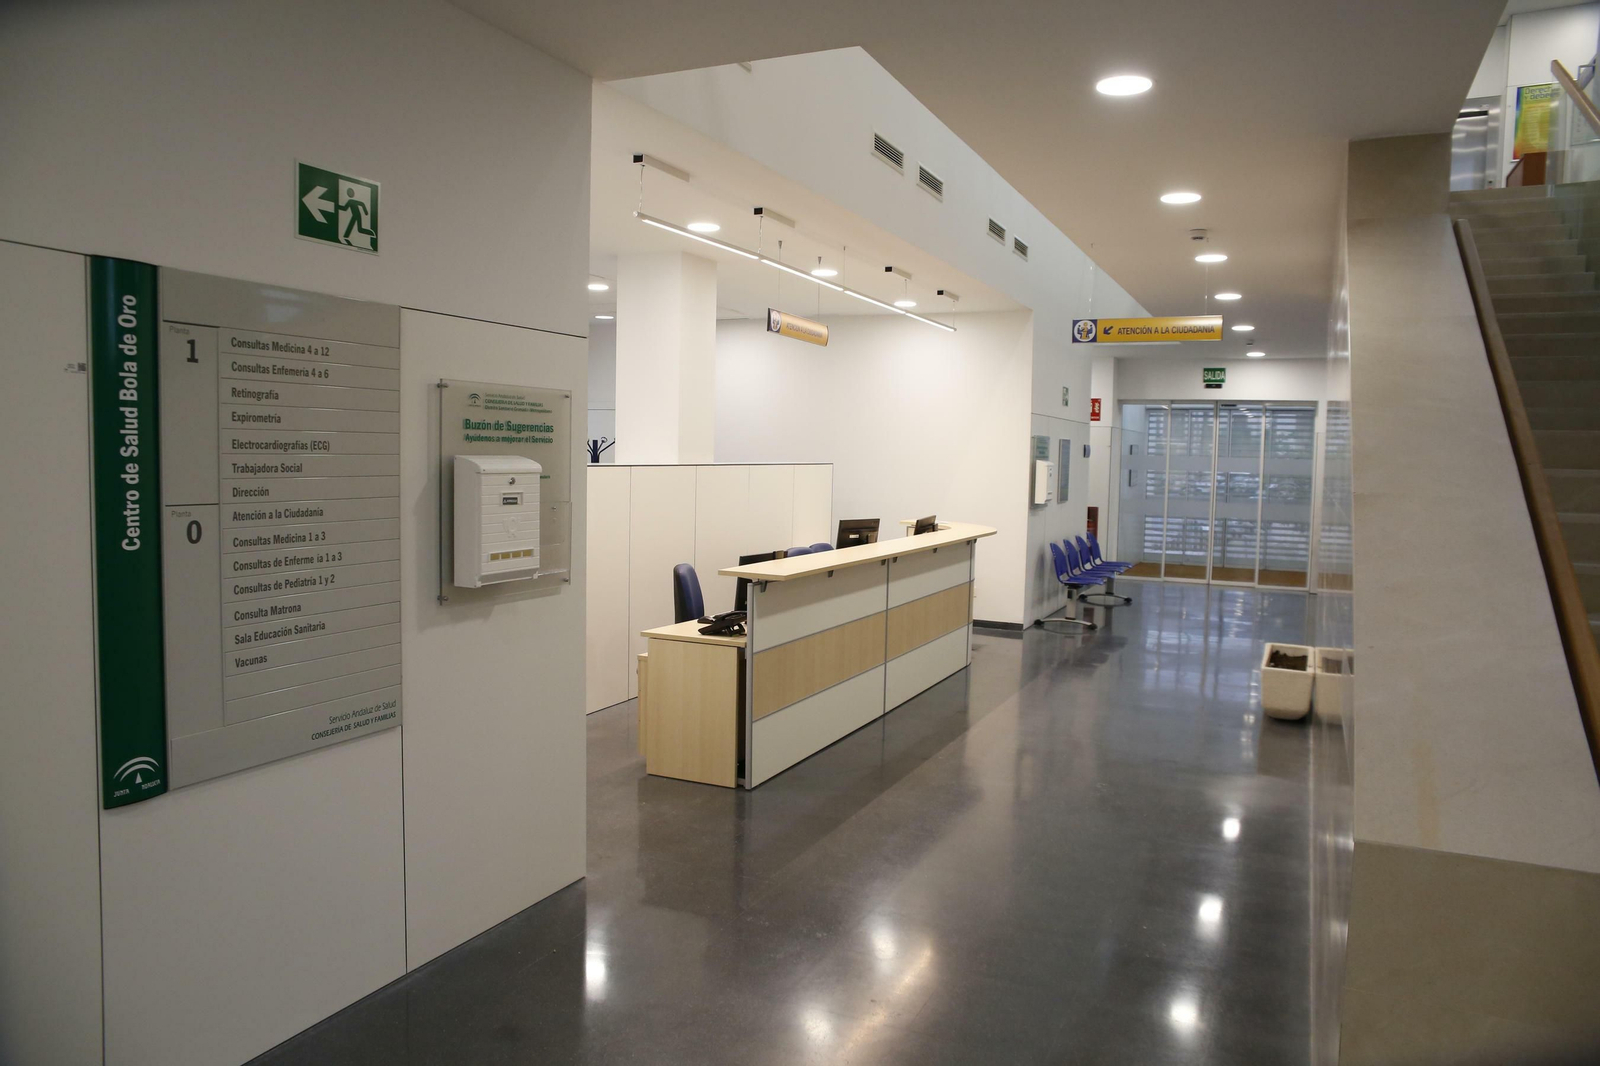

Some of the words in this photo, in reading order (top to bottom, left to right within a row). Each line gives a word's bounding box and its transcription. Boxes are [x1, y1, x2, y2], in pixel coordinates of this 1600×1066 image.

[117, 294, 137, 328] Oro
[169, 325, 190, 335] Planta
[1118, 325, 1152, 334] ATENCIÓN
[1154, 326, 1159, 334] A
[1161, 326, 1170, 334] LA
[1171, 324, 1215, 334] CIUDADANÍA
[118, 334, 137, 356] de
[186, 339, 198, 363] 1
[231, 337, 270, 350] Consultas
[272, 341, 305, 354] Medicina
[307, 345, 312, 354] 4
[321, 347, 330, 356] 12
[231, 361, 270, 374] Consultas
[311, 368, 316, 377] 4
[324, 369, 329, 379] 6
[1204, 370, 1225, 380] SALIDA
[118, 361, 138, 401] Bola
[119, 407, 139, 457] Salud
[464, 418, 492, 430] Buzón
[494, 420, 504, 431] de
[506, 420, 554, 434] Sugerencias
[310, 440, 330, 452] (ECG)
[501, 435, 525, 444] mejorar
[120, 463, 139, 484] de
[232, 463, 279, 475] Trabajadora
[280, 463, 303, 473] Social
[232, 487, 269, 497] Dirección
[121, 490, 140, 551] Centro
[171, 510, 191, 518] Planta
[232, 510, 266, 521] Atención
[275, 509, 282, 519] la
[284, 507, 324, 518] Ciudadanía
[186, 520, 202, 544] 0
[233, 536, 271, 548] Consultas
[273, 533, 306, 544] Medicina
[308, 532, 312, 541] 1
[321, 531, 326, 540] 3
[233, 559, 271, 571] Consultas
[274, 558, 282, 568] de
[326, 553, 329, 562] 1
[338, 551, 342, 561] 3
[234, 582, 271, 595] Consultas
[274, 580, 282, 590] de
[319, 575, 323, 584] 1
[324, 577, 329, 586] y
[330, 574, 335, 583] 2
[234, 608, 268, 621] Consulta
[270, 604, 302, 616] Matrona
[234, 633, 252, 645] Sala
[254, 626, 292, 641] Educación
[294, 621, 326, 634] Sanitaria
[235, 655, 268, 668] Vacunas
[328, 712, 350, 724] Servicio
[352, 706, 374, 718] Andaluz
[382, 700, 397, 710] Salud
[344, 723, 352, 731] DE
[353, 719, 370, 729] SALUD
[374, 711, 396, 723] FAMILIAS
